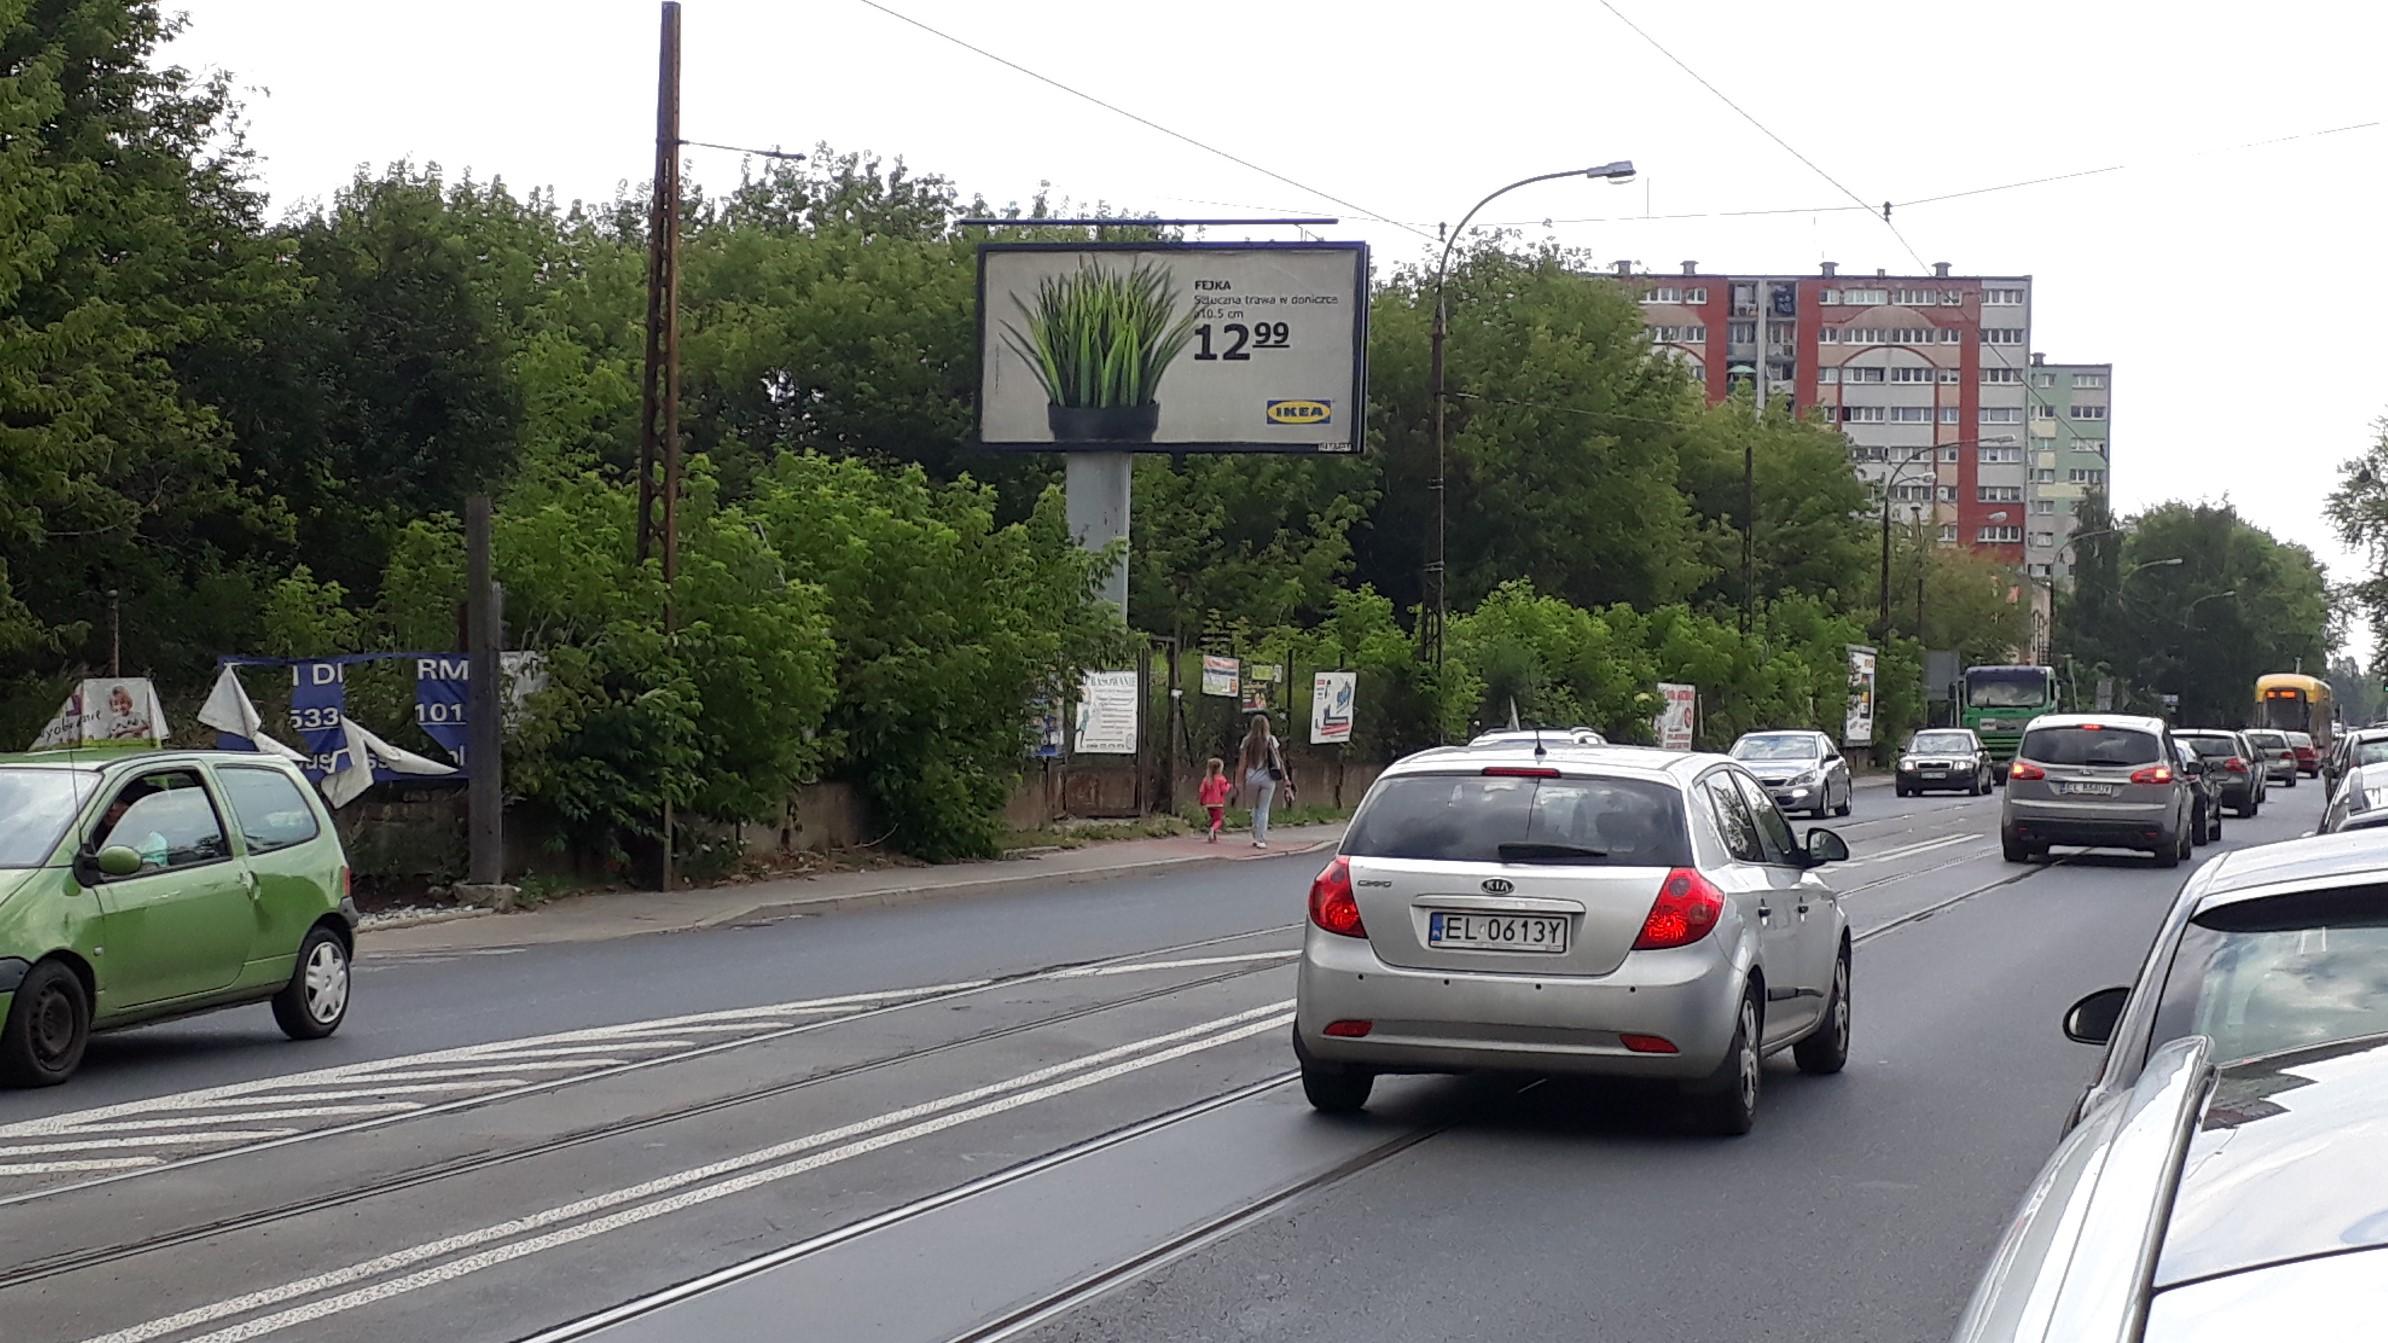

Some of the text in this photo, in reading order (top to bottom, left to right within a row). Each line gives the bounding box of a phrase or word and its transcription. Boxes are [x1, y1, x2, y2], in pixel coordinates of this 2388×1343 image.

[1194, 280, 1232, 291] FEJKA
[1194, 294, 1339, 305] Sztuczna trawa w doniczce
[1227, 310, 1244, 319] cm
[1276, 407, 1324, 417] IKEA
[414, 703, 463, 722] 101
[1446, 917, 1561, 943] EL 0613Y
